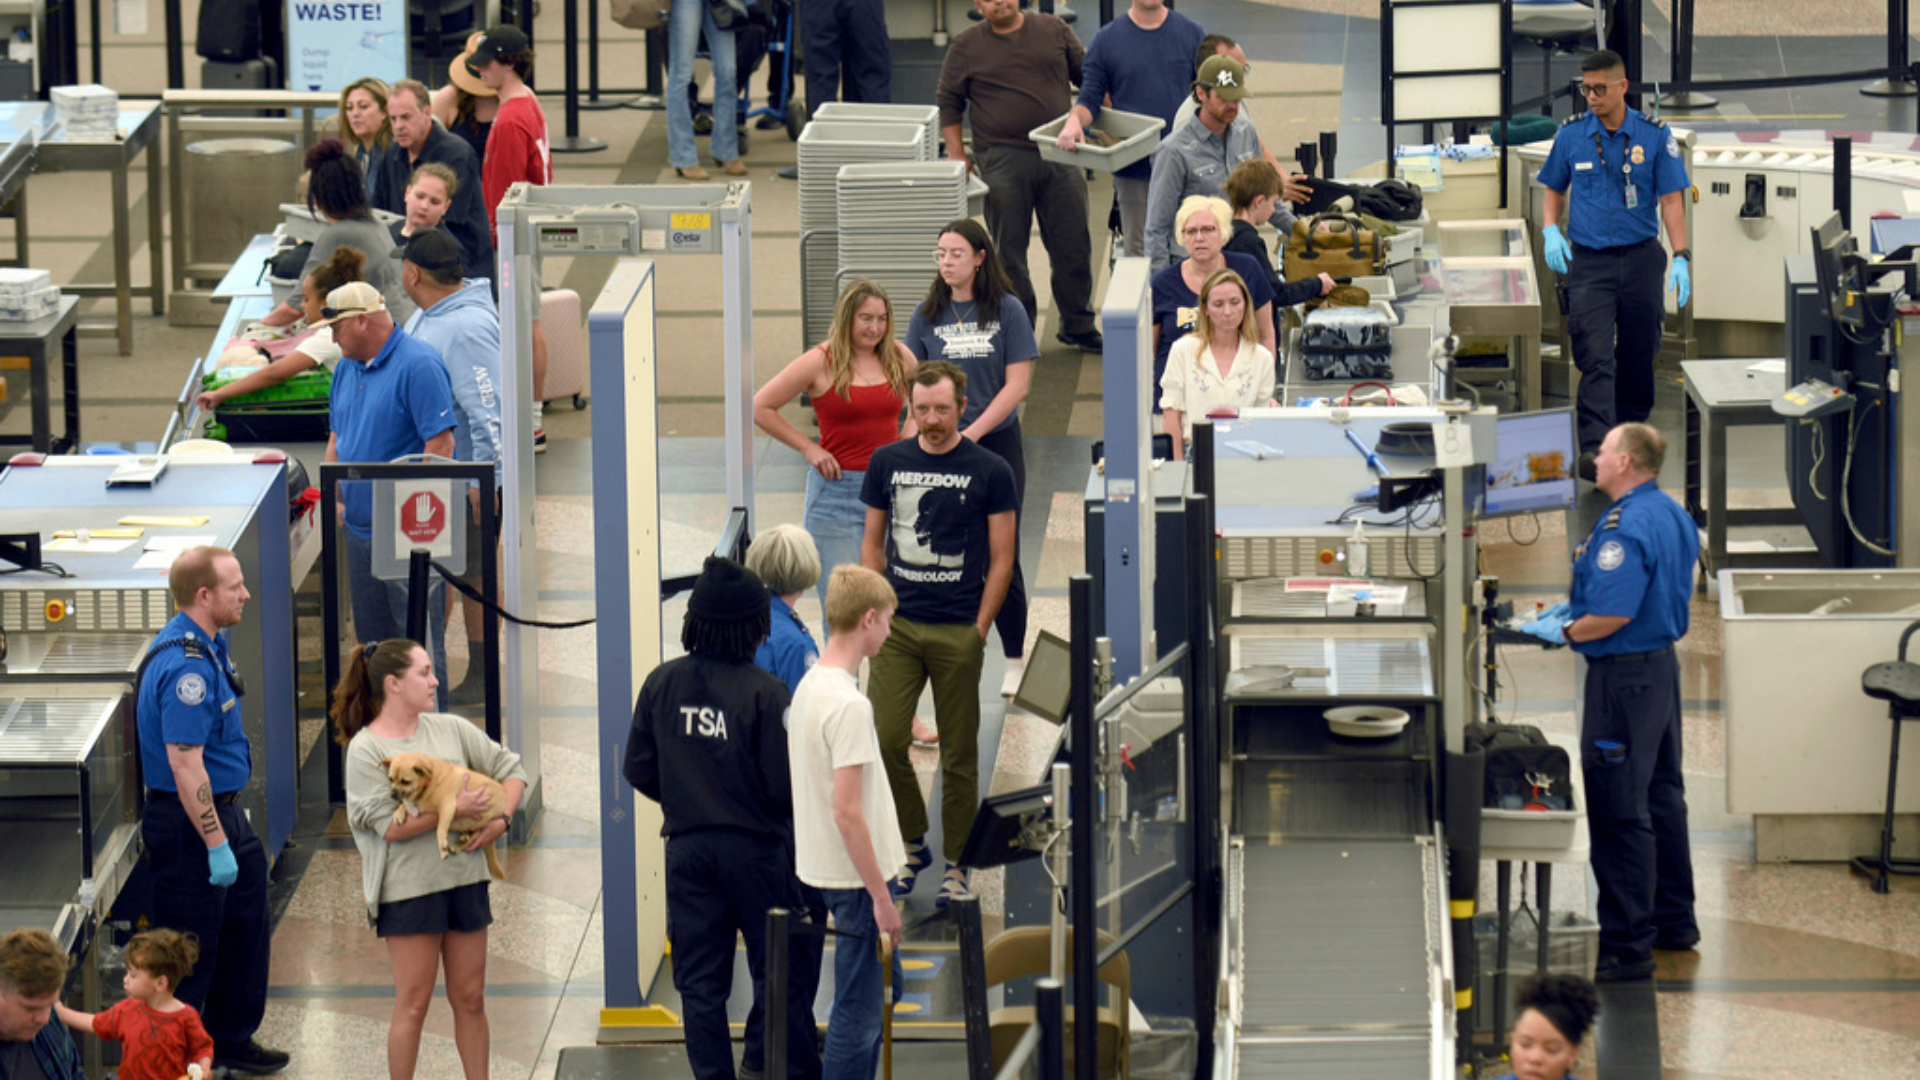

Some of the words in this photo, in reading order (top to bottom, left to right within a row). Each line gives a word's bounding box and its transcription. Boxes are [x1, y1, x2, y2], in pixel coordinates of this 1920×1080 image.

[296, 3, 382, 21] WASTE!
[302, 47, 330, 58] Dump
[472, 366, 496, 408] CREW
[891, 469, 972, 488] MERZBOW
[680, 706, 728, 740] TSA
[200, 805, 218, 835] VII
